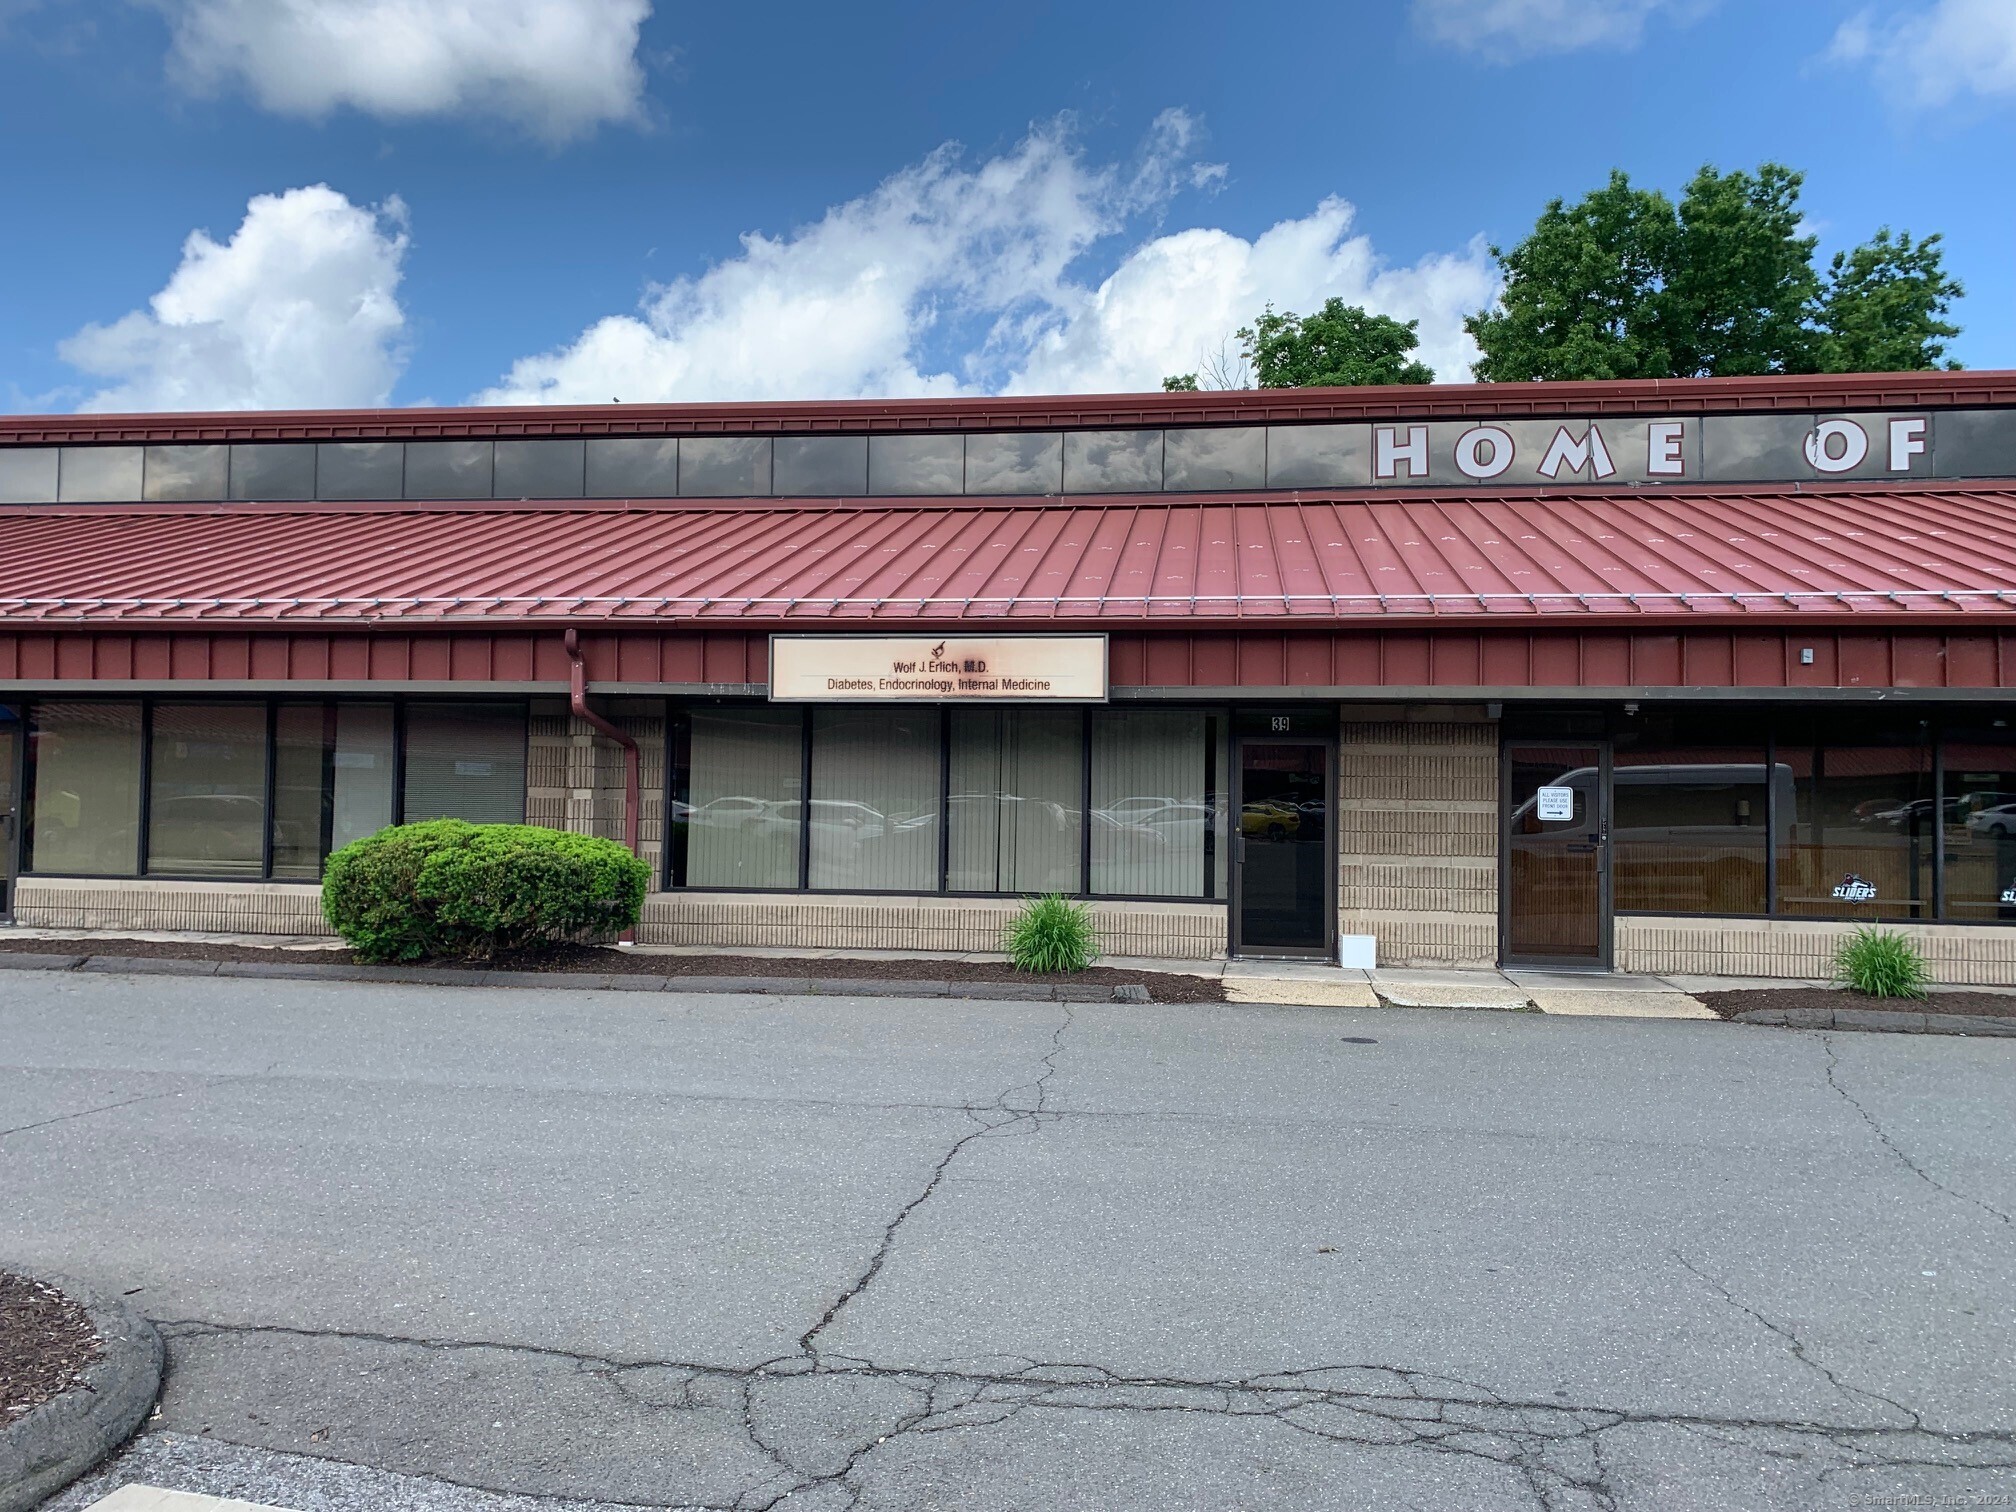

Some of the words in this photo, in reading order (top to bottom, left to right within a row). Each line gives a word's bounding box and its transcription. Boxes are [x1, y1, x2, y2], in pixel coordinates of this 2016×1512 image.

[1375, 421, 1685, 480] HOME
[1803, 417, 1927, 474] OF
[893, 661, 916, 673] Wolf
[919, 661, 927, 673] J.
[929, 661, 962, 675] Erlich,
[964, 660, 989, 673] M.D.
[827, 678, 876, 691] Diabetes,
[879, 678, 956, 692] Endocrinology,
[958, 678, 998, 691] Internal
[1002, 678, 1051, 691] Medicine
[1272, 717, 1289, 730] 39
[1833, 887, 1877, 898] SLIDERS
